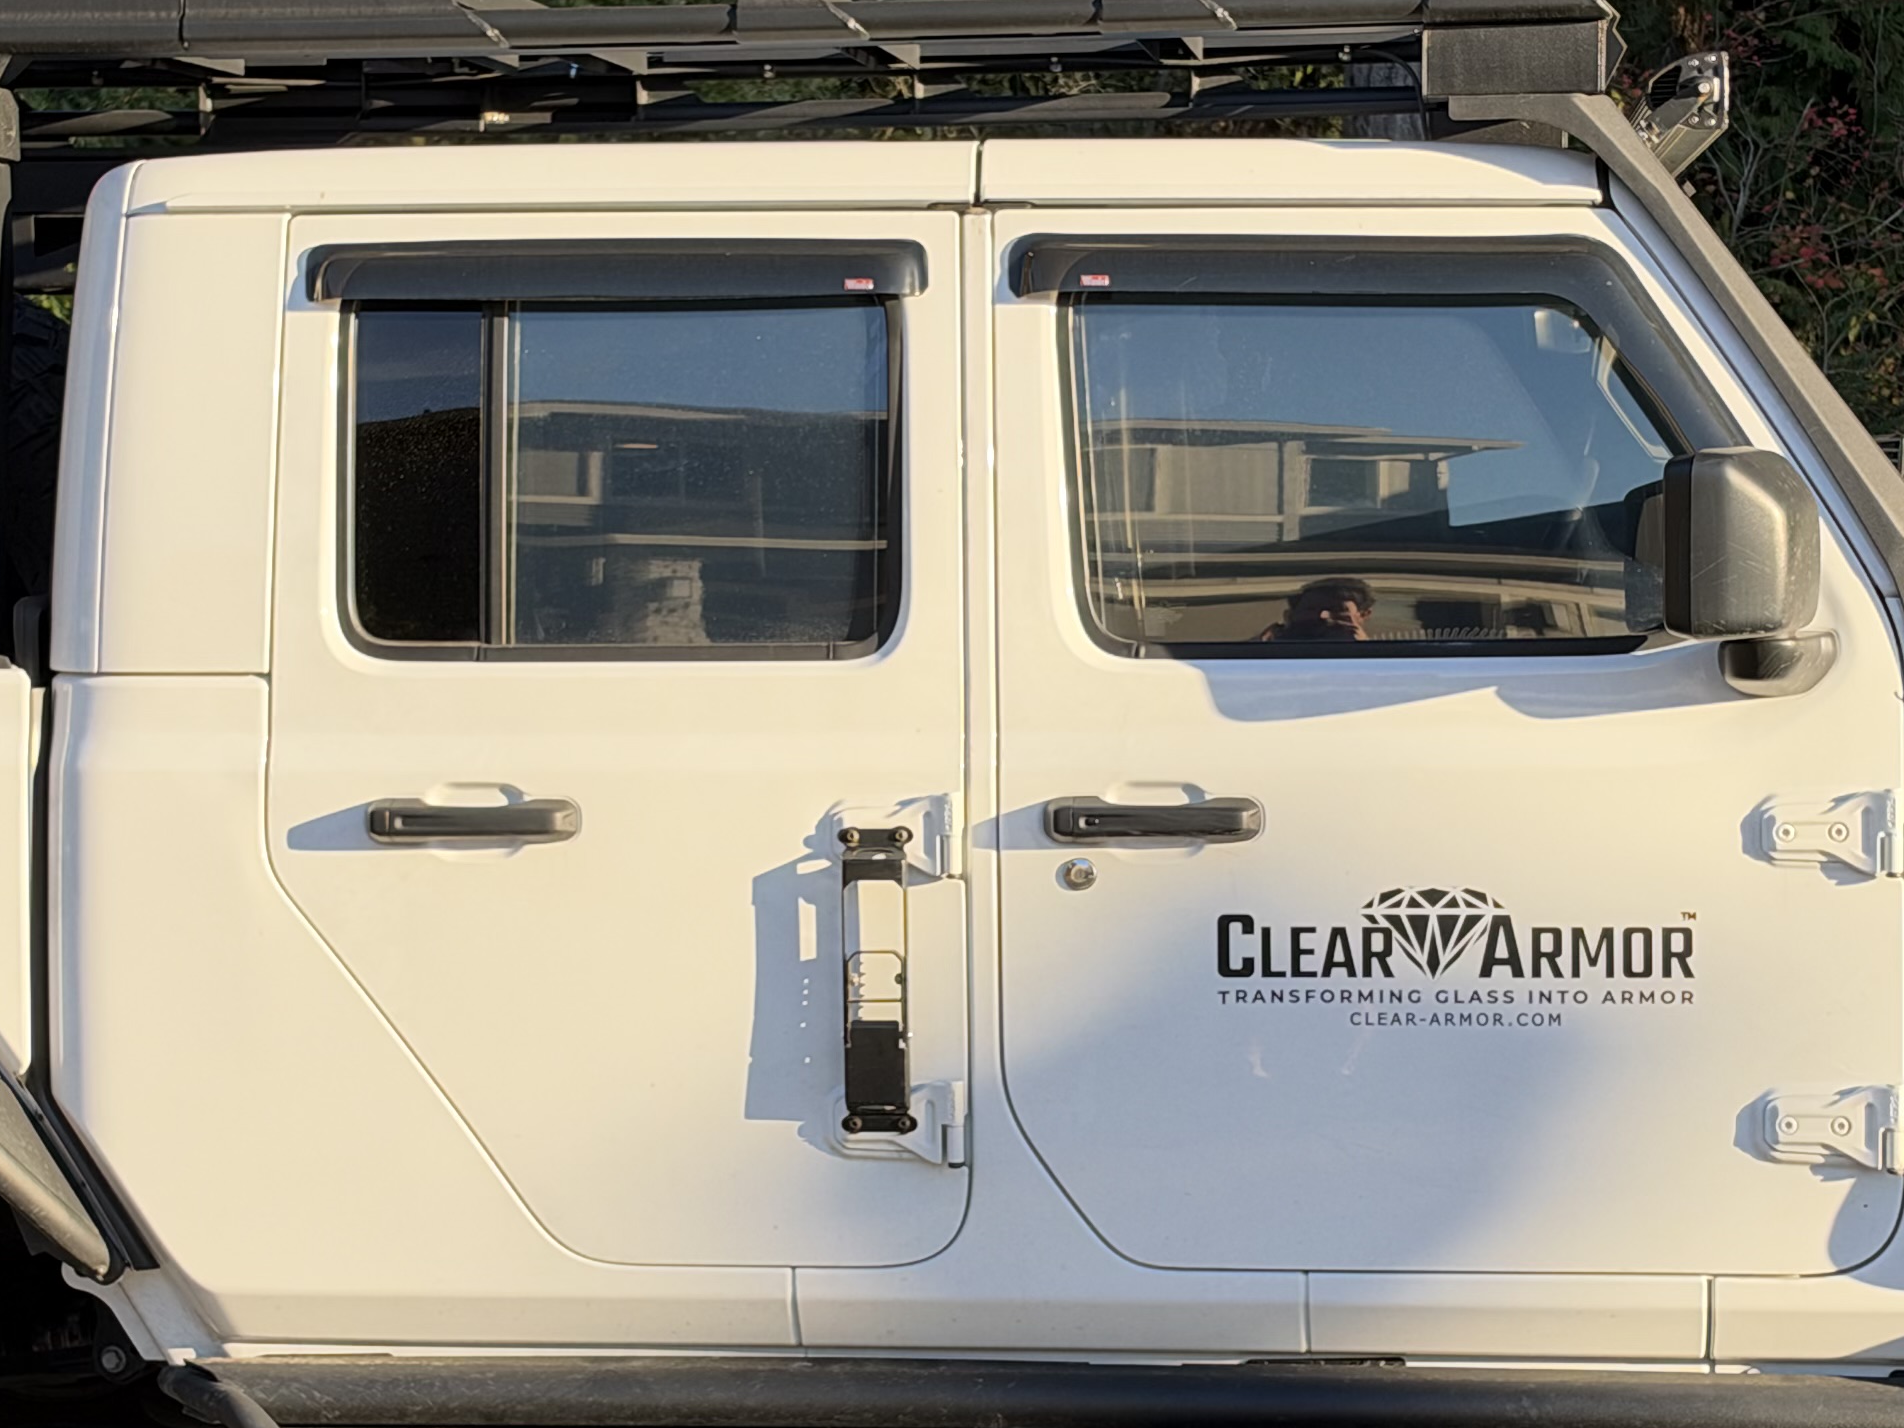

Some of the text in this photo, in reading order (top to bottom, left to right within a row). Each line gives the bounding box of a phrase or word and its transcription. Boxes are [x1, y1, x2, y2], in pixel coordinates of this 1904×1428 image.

[1215, 912, 1396, 979] CLEAR
[1478, 913, 1696, 979] ARMOR
[1217, 988, 1696, 1005] TRANSFORMING GLASS INTO ARMOR
[1349, 1011, 1563, 1027] CLEAR-ARMOR.COM
